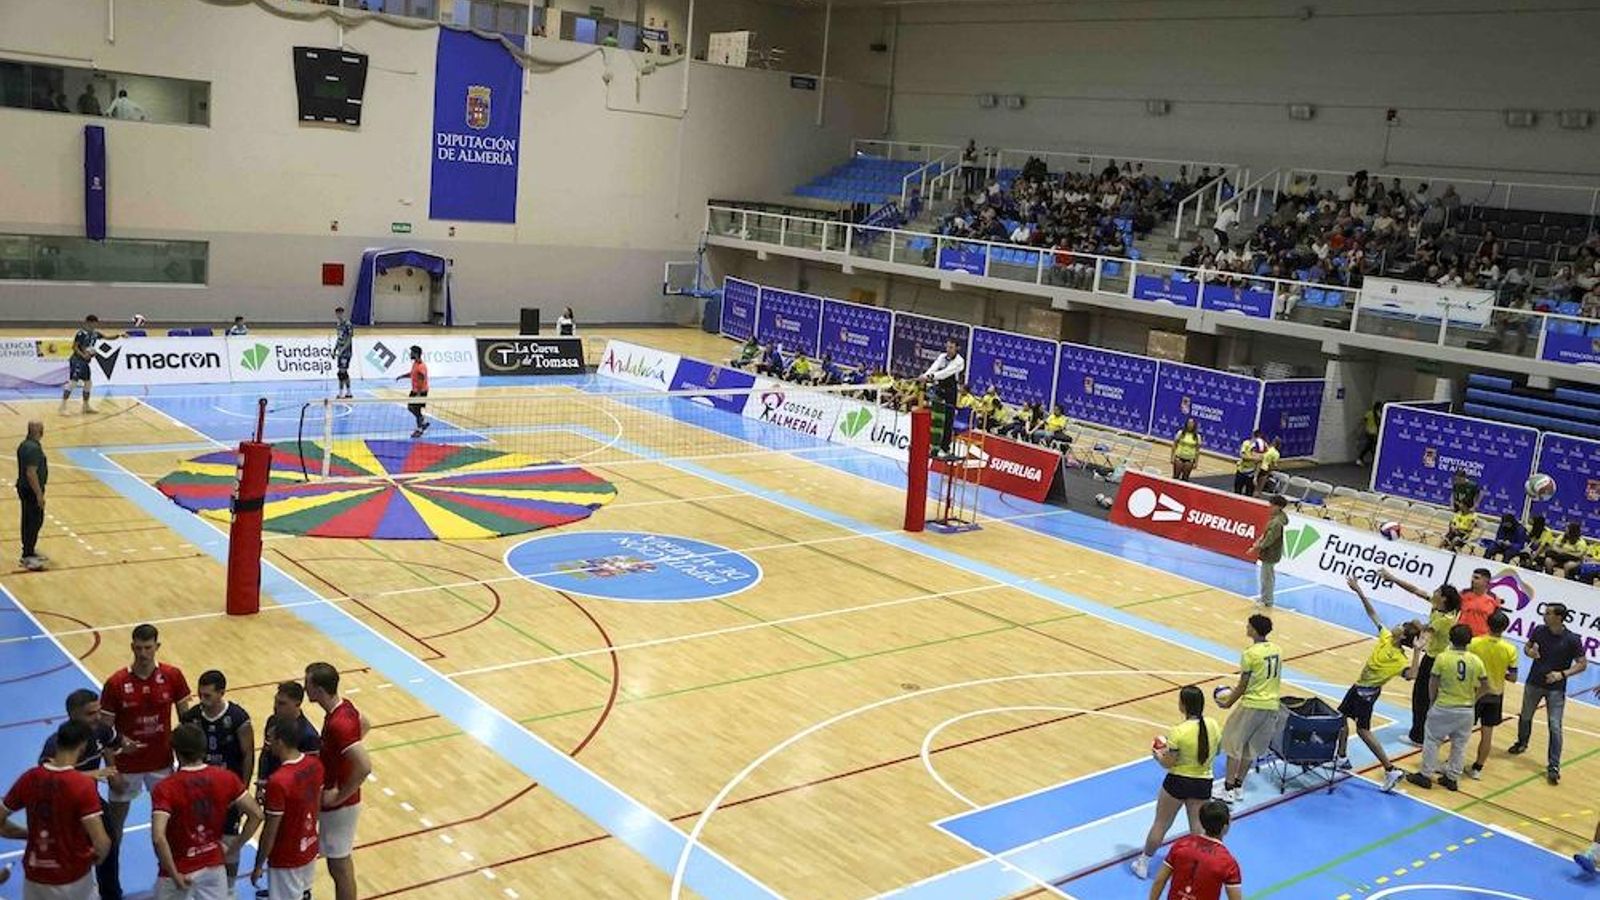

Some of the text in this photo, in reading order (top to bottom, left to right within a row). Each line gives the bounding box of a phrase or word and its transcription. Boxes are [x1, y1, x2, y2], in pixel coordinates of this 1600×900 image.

[437, 132, 516, 151] DIPUTACIÓN
[438, 147, 513, 165] DE ALMERÍA
[275, 344, 333, 358] Fundaci
[514, 342, 559, 354] La Cueva
[126, 352, 220, 369] macron
[278, 357, 332, 375] Unicaja
[531, 353, 579, 369] Tomasa
[769, 412, 818, 436] ALMERÍA
[871, 424, 911, 450] Unic
[989, 457, 1042, 482] SUPERLIGA
[1186, 508, 1257, 540] SUPERLIGA
[1324, 533, 1434, 579] Fundación
[1536, 601, 1600, 632] CSTA
[1264, 654, 1280, 680] 17
[1456, 659, 1467, 682] 9
